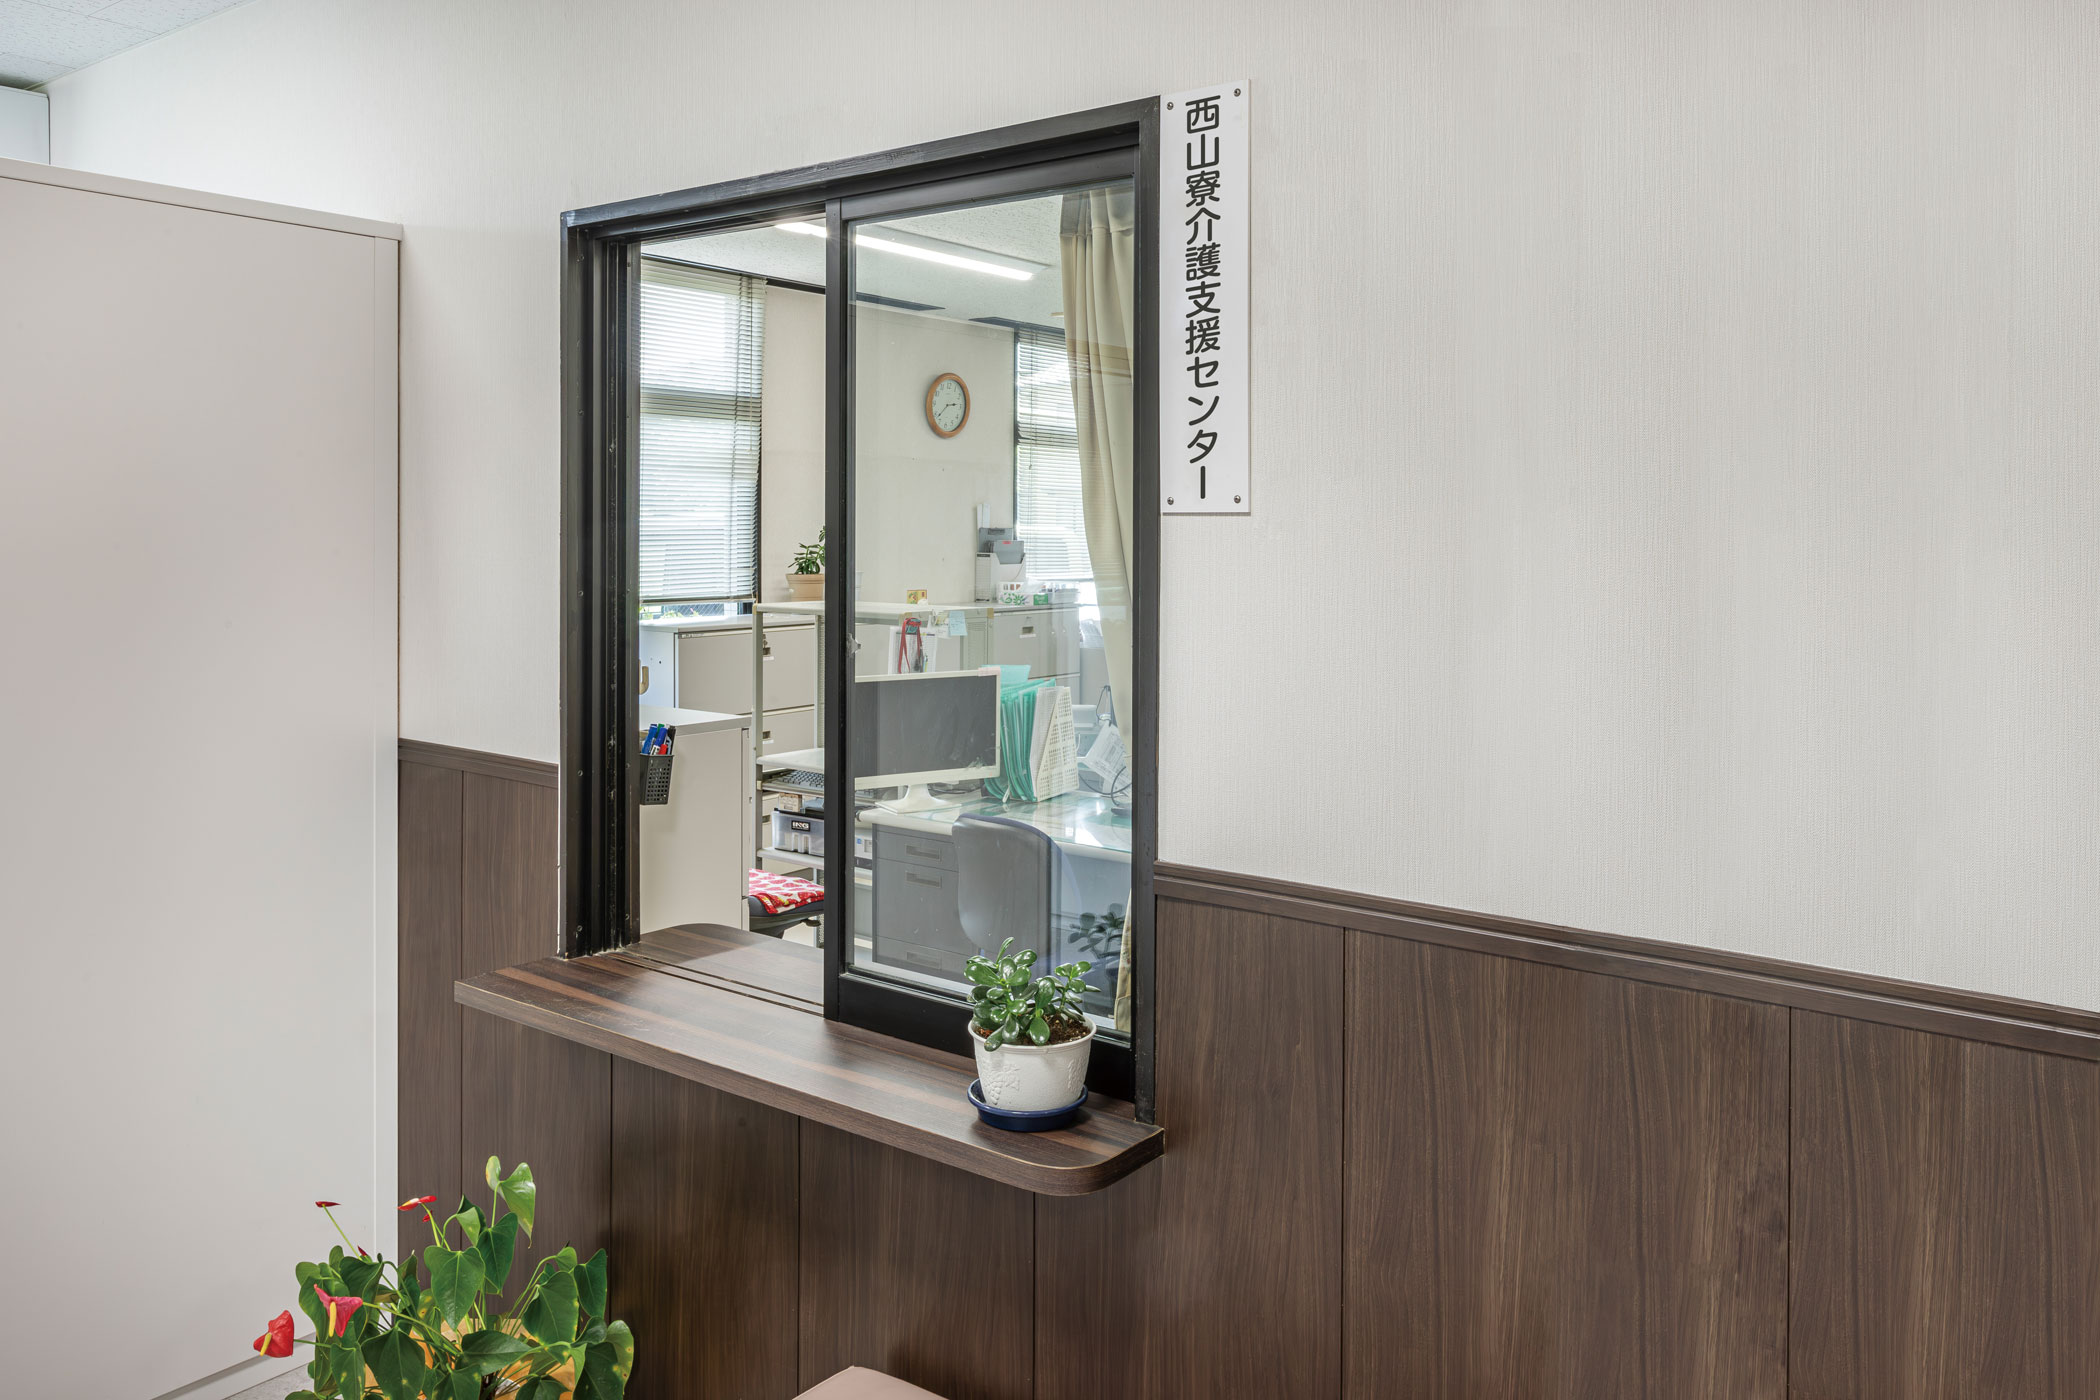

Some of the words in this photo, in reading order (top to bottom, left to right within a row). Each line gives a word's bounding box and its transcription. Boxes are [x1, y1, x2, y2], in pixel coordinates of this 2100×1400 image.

[1185, 95, 1221, 500] 西山寮介護支援センター
